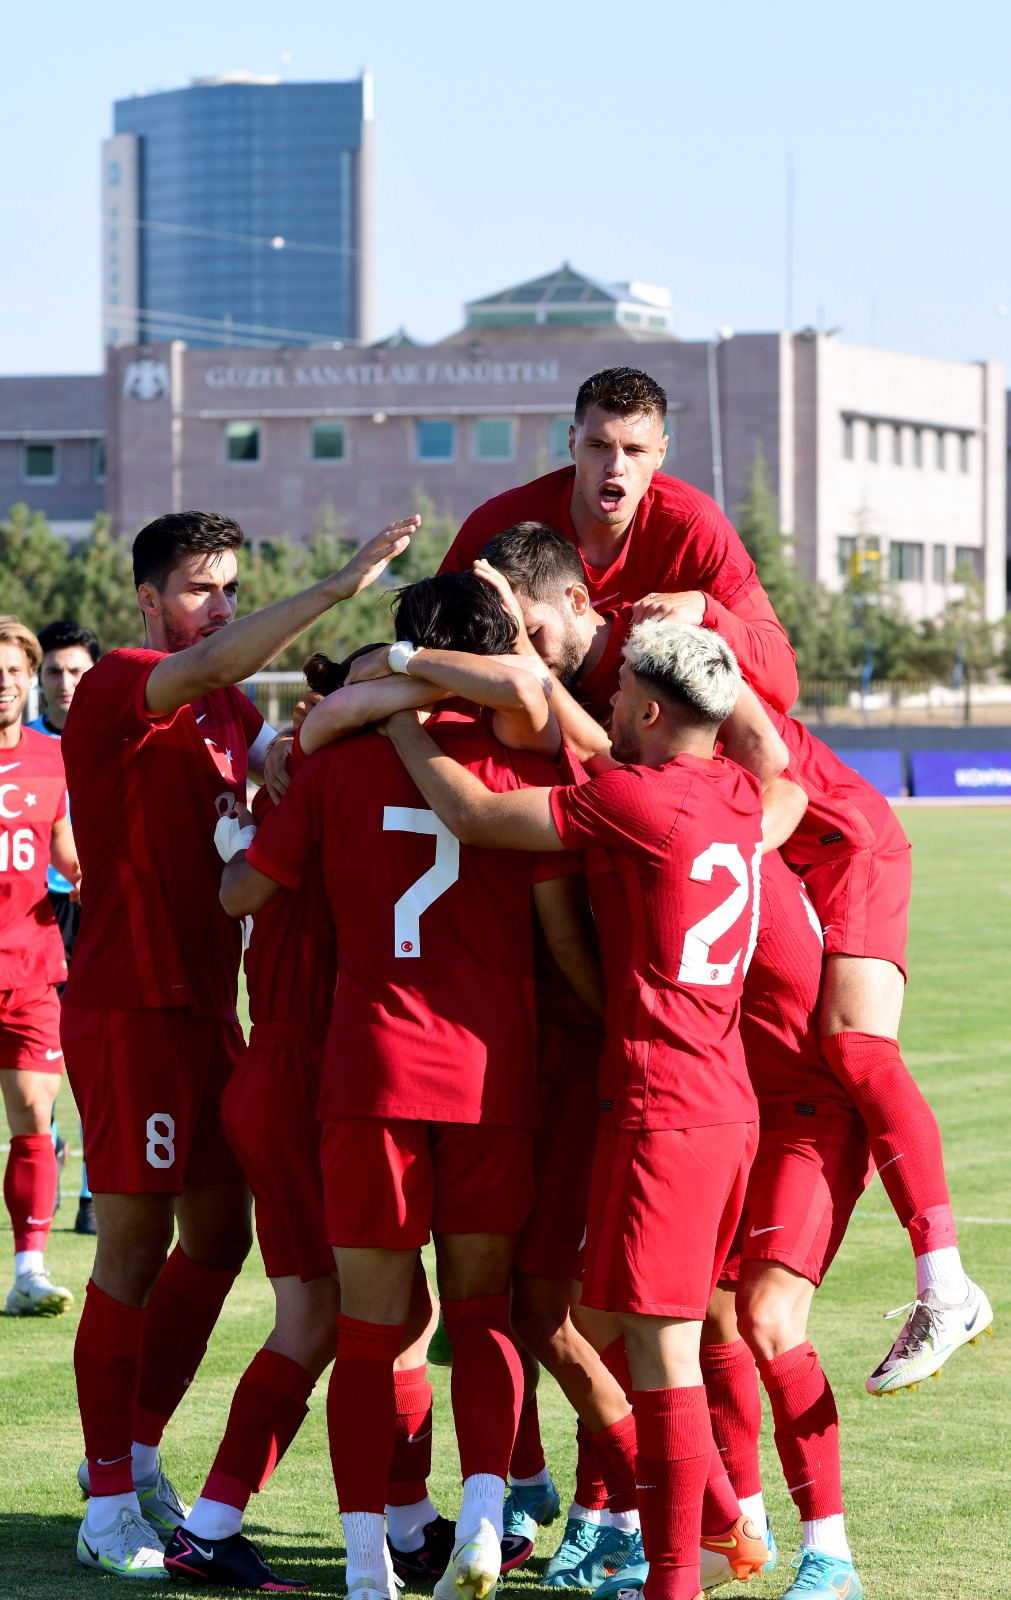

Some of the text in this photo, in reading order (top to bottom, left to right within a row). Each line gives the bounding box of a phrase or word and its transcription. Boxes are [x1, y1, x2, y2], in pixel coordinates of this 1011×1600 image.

[205, 362, 289, 389] GÜZEL
[292, 361, 421, 388] SANATLAR
[0, 829, 35, 871] 16
[383, 806, 460, 958] 7
[146, 1113, 175, 1168] 8
